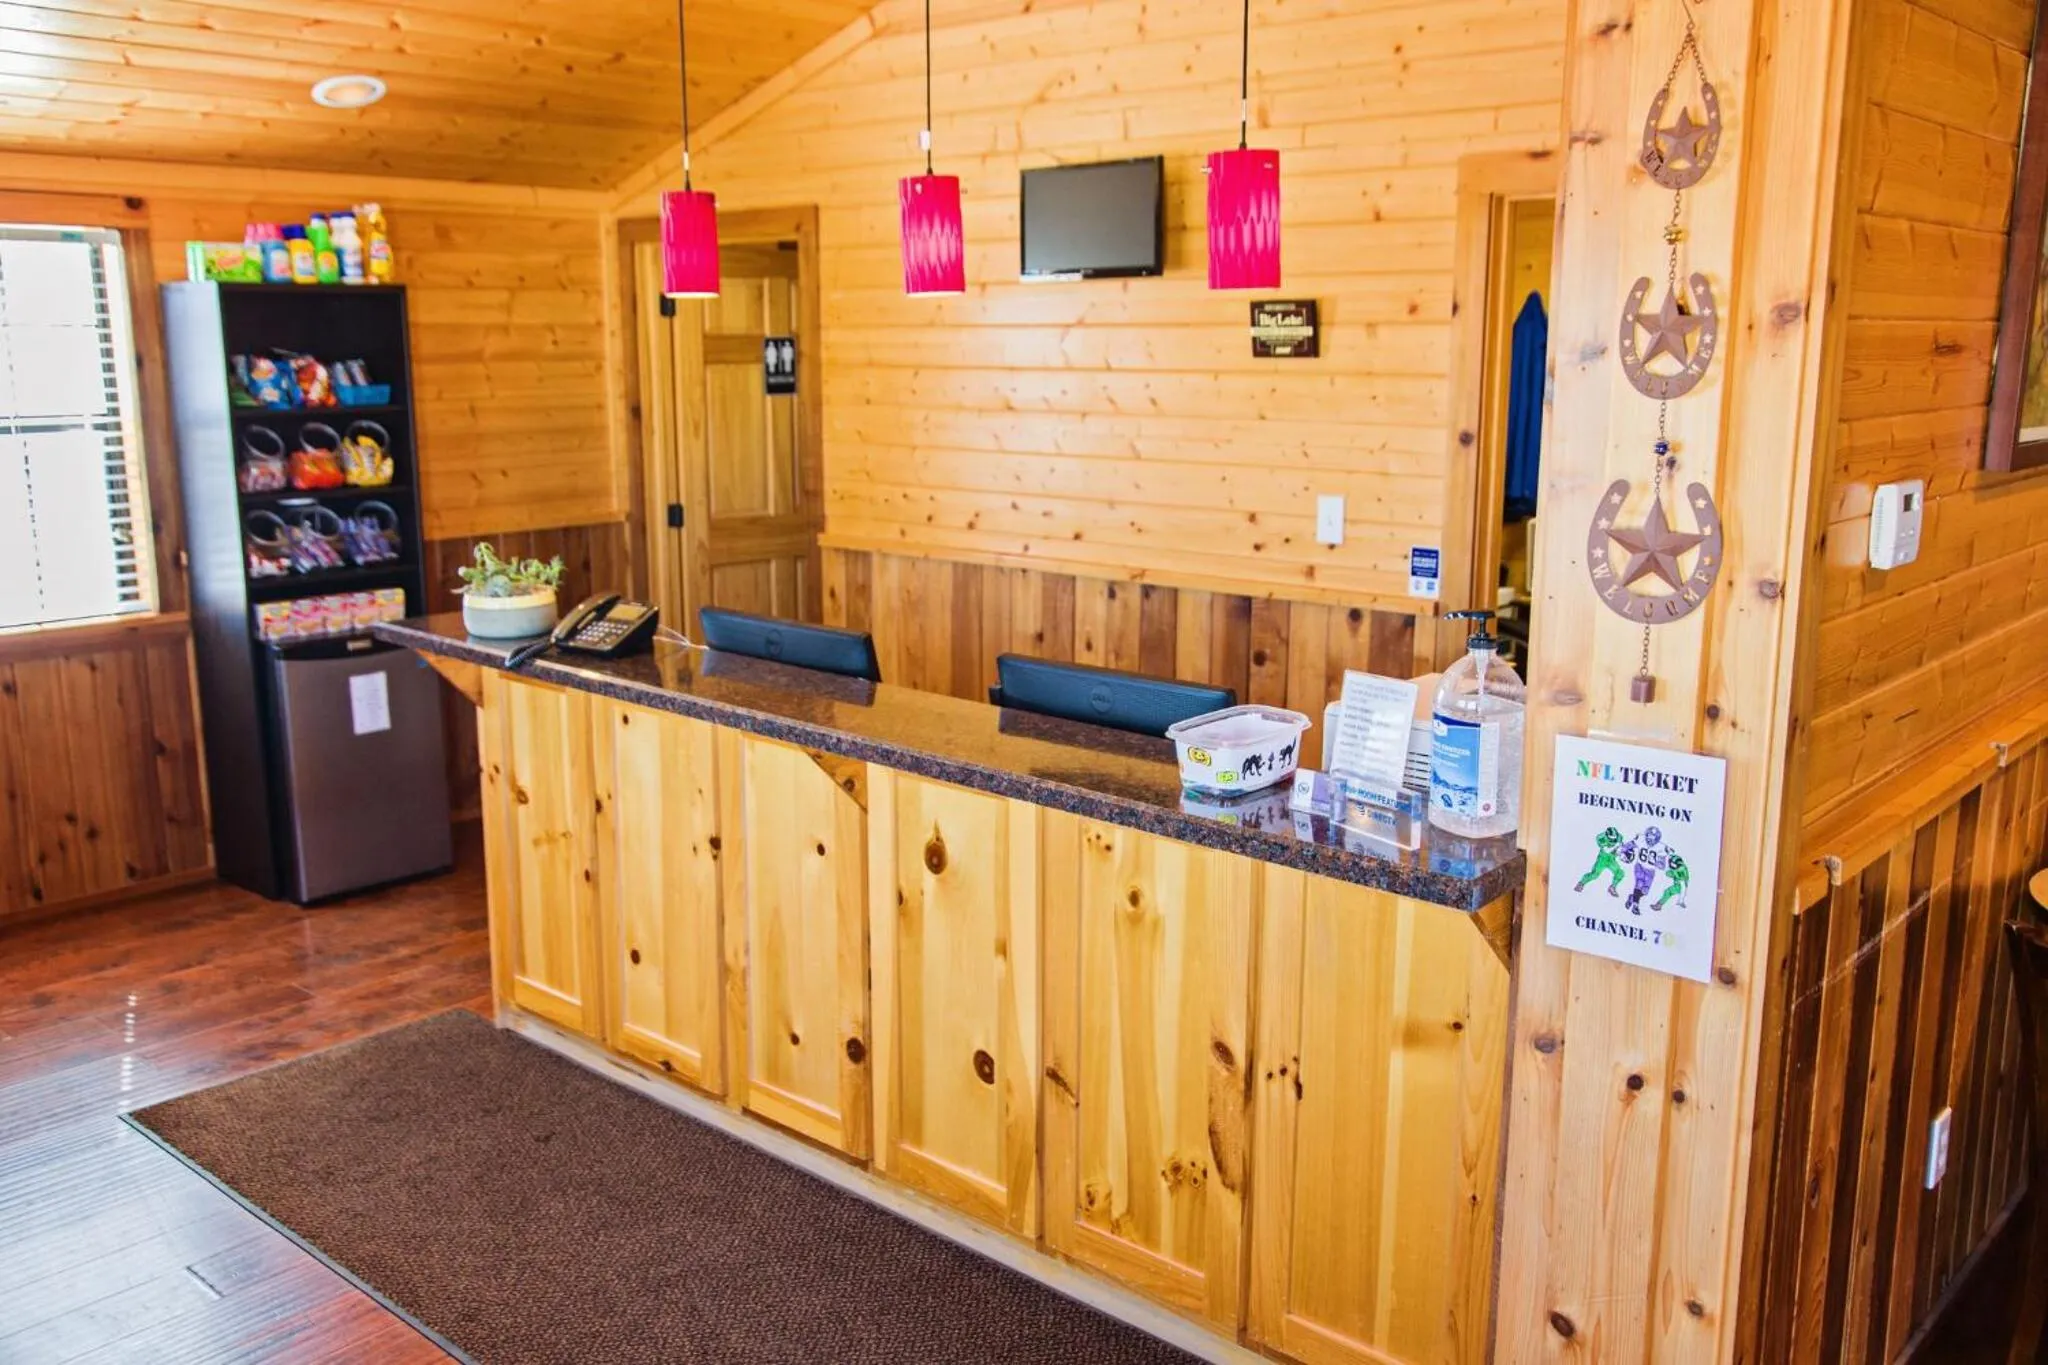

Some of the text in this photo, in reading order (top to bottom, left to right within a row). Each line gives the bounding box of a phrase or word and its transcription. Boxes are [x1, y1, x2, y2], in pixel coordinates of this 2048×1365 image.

[1623, 347, 1713, 396] WELCME
[1592, 561, 1711, 619] WELCOME
[1576, 759, 1698, 794] NFL TICKET
[1578, 791, 1693, 823] BEGINNING ON
[1639, 847, 1657, 866] 63
[1575, 915, 1647, 942] CHANNEL
